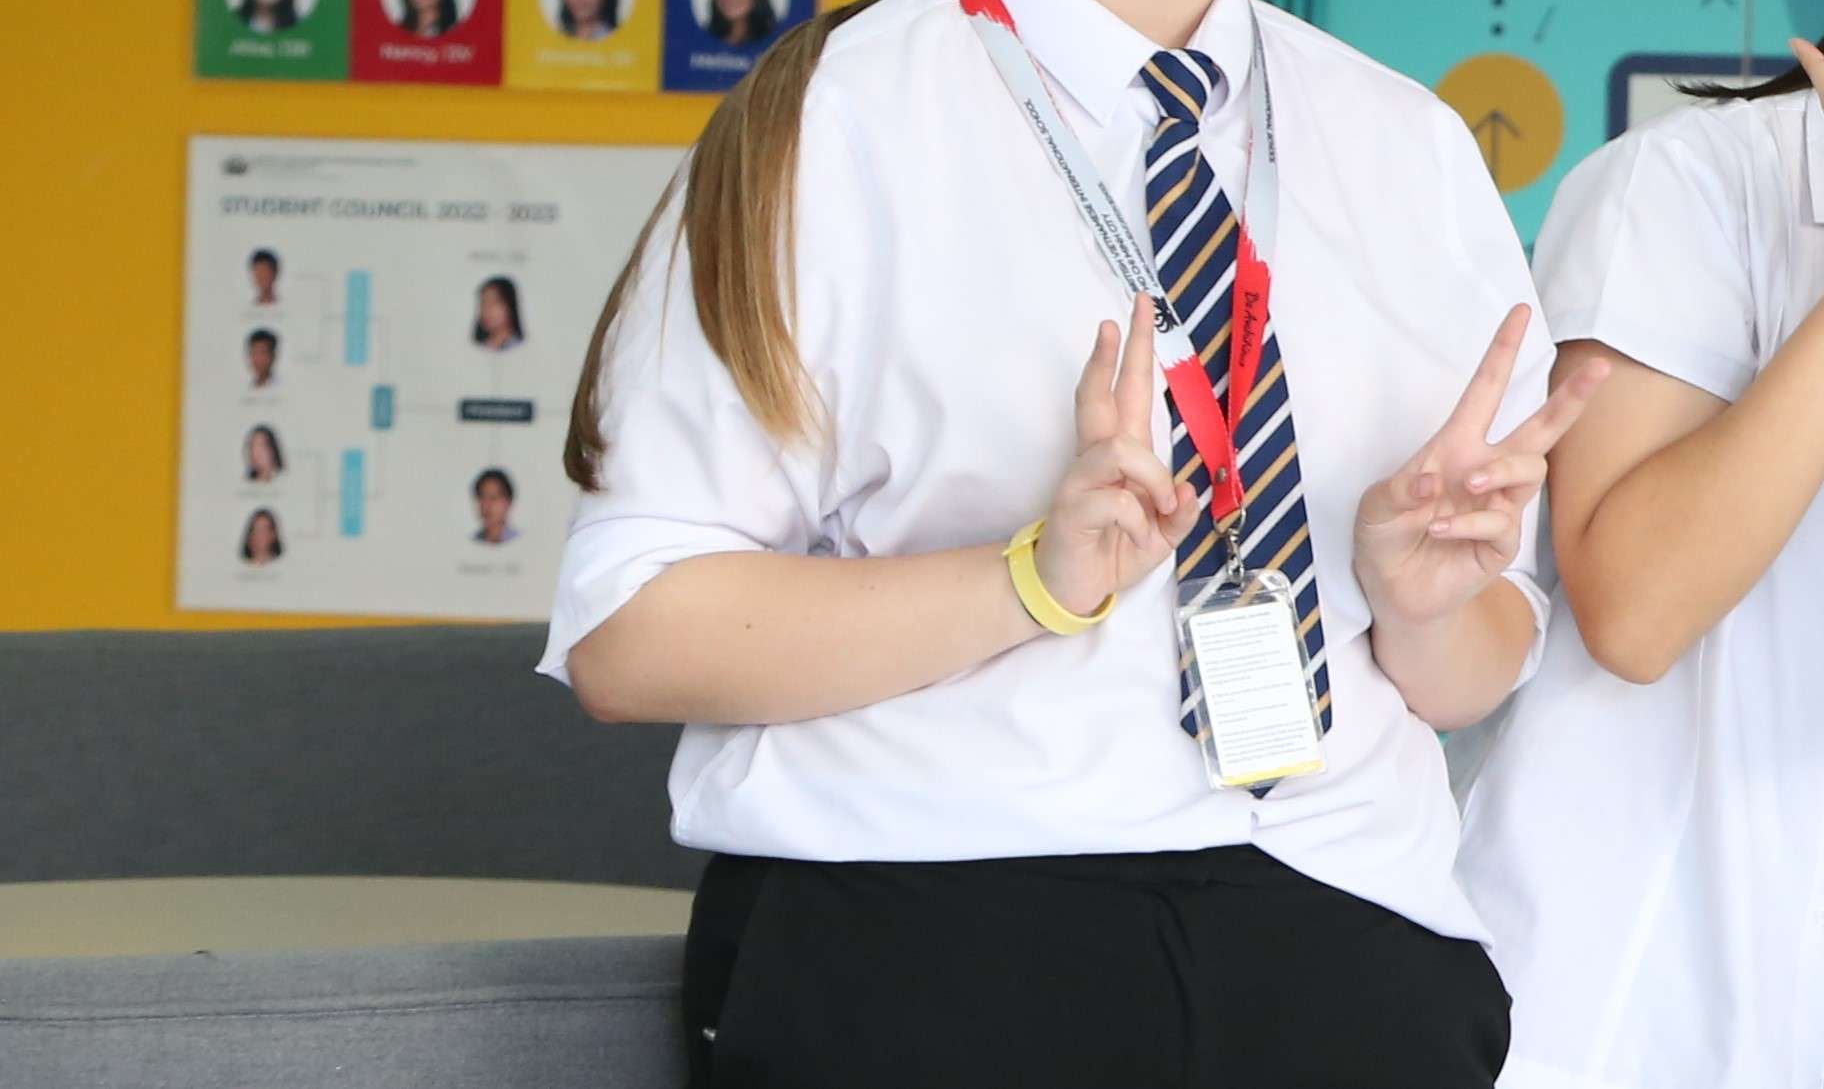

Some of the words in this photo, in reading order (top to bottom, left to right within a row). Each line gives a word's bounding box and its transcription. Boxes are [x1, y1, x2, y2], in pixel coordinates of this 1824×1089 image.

[1023, 97, 1049, 138] SCHOOL
[1045, 134, 1088, 203] INTERNATIONAL
[221, 195, 323, 216] STUDENT
[328, 197, 429, 219] COUNCIL
[1102, 212, 1118, 235] CITY
[1085, 202, 1121, 261] VIETNAMESE
[1113, 232, 1133, 260] MINH
